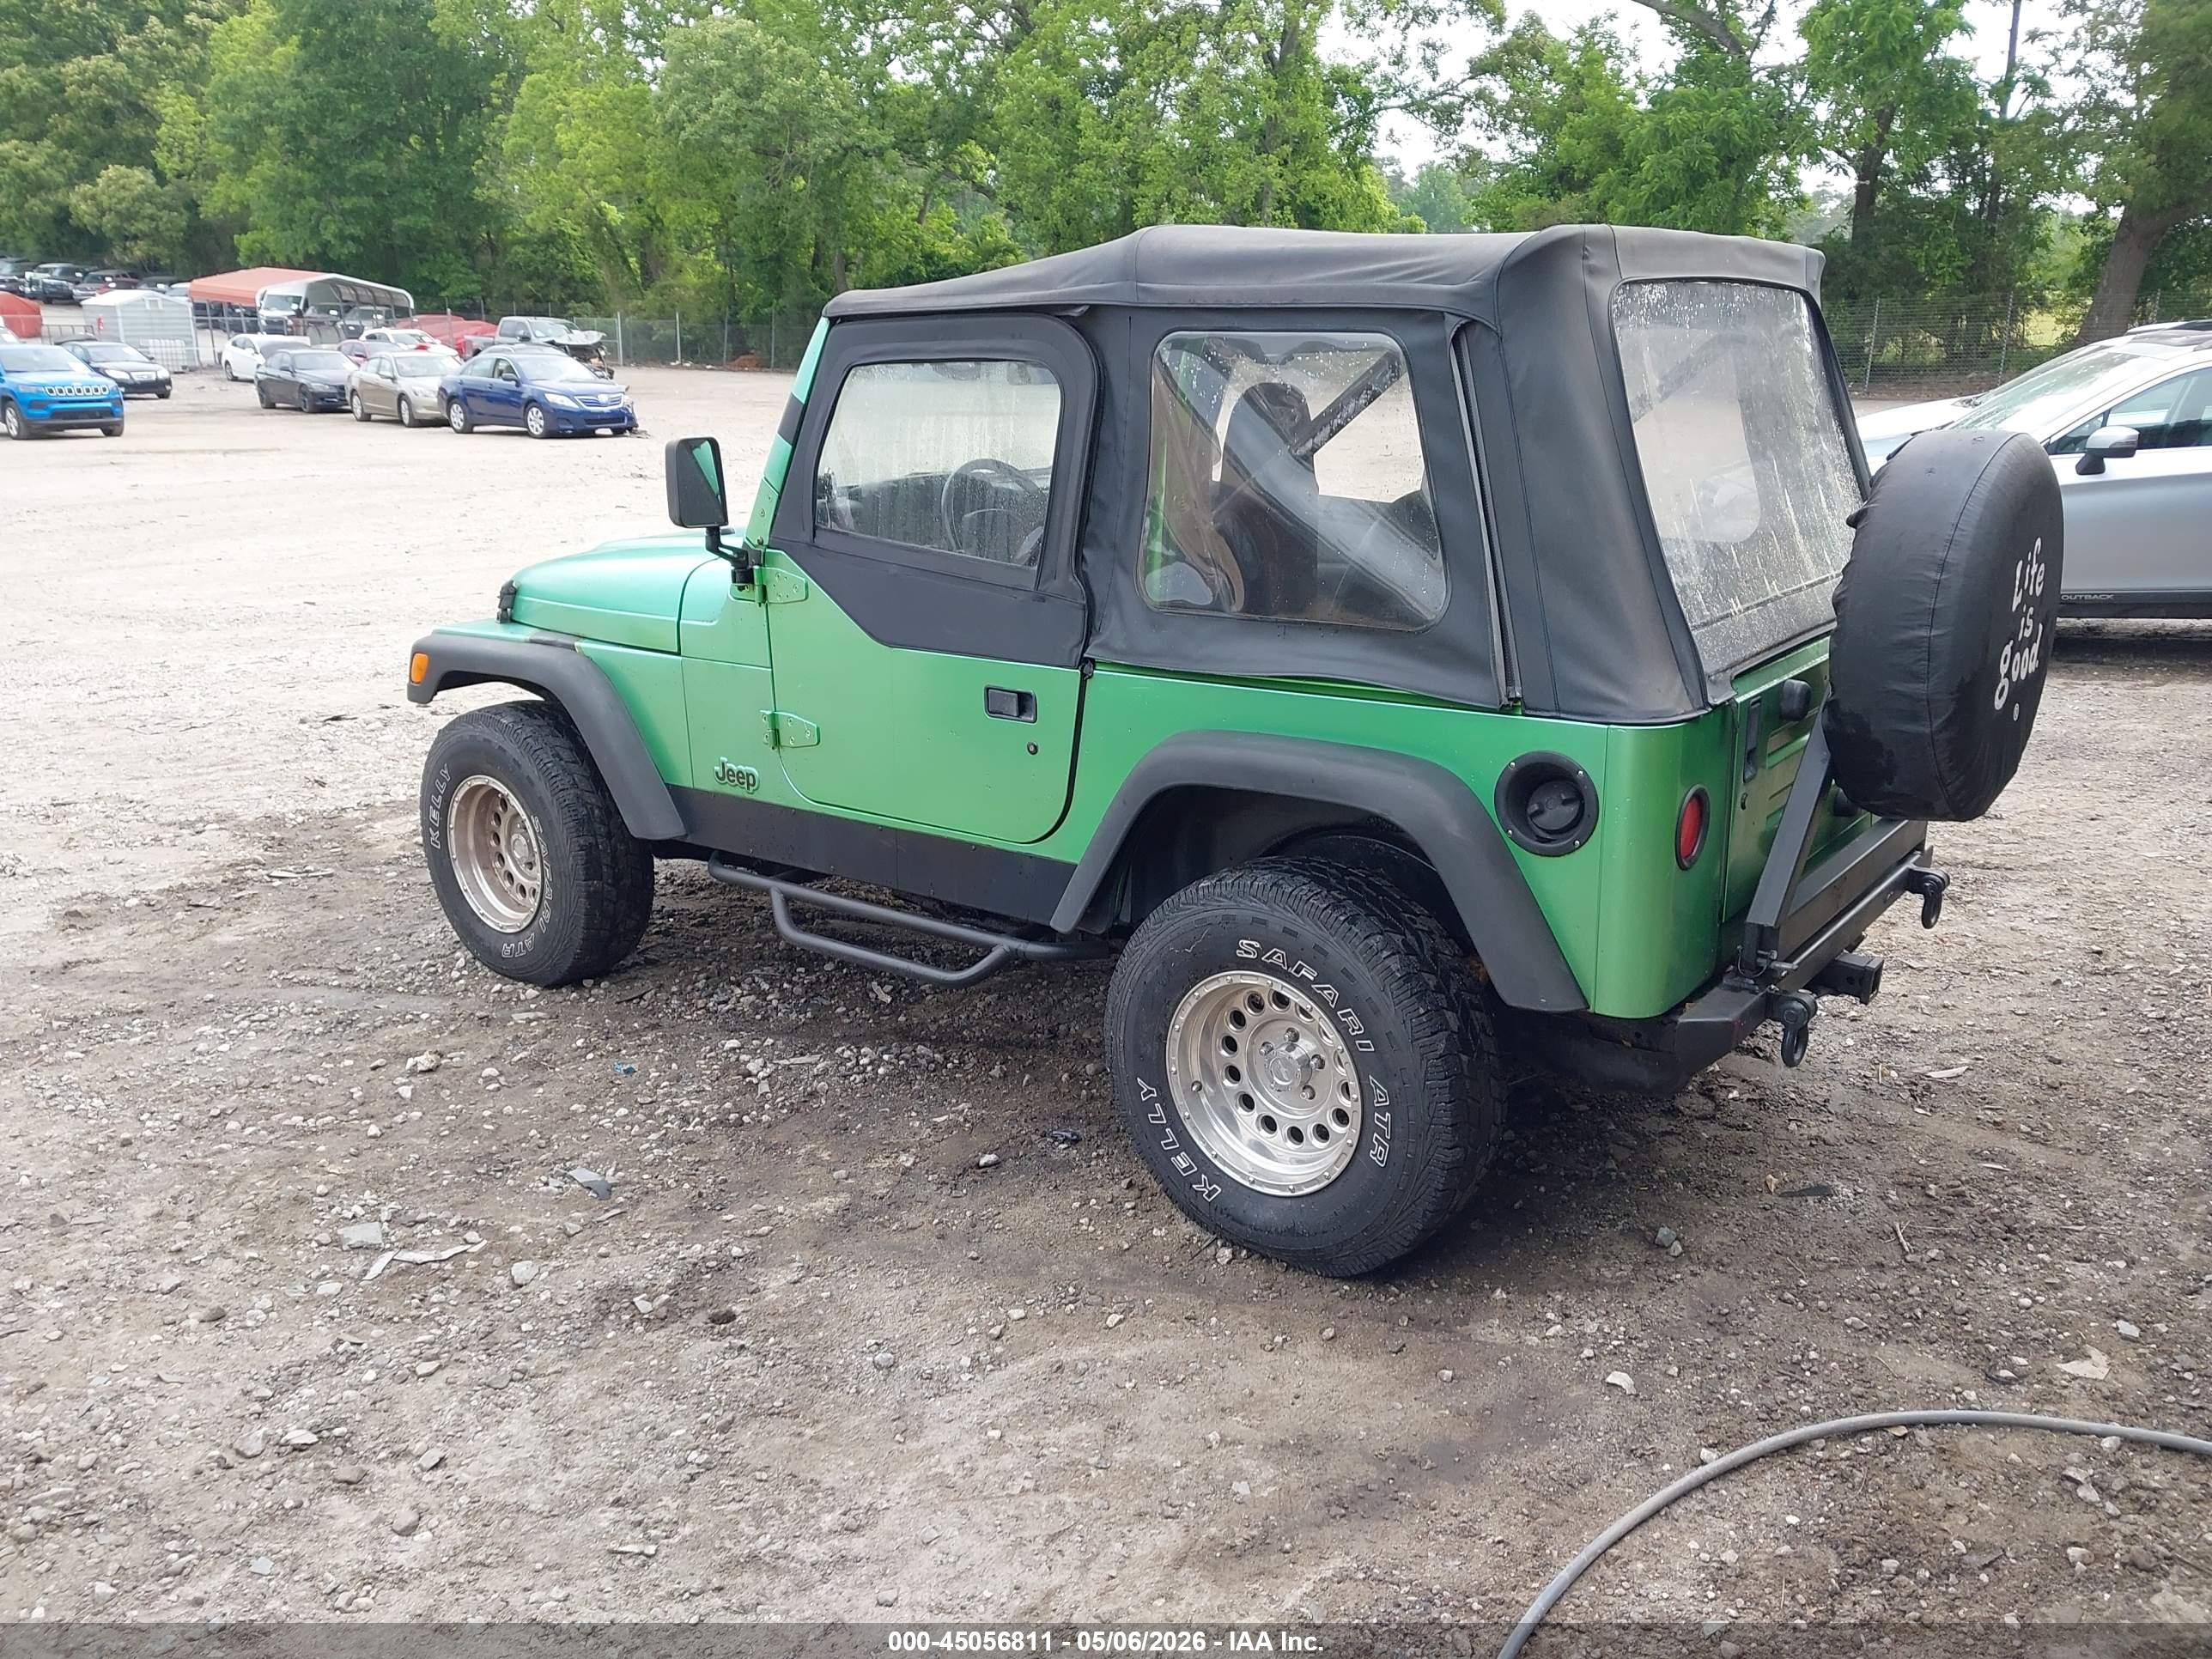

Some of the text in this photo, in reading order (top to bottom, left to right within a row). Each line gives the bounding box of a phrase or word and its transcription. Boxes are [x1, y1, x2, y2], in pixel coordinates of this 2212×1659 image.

[2011, 537, 2045, 612] Life
[2018, 604, 2034, 641] is
[430, 763, 452, 850] KELLY
[714, 757, 759, 793] Jeep
[501, 815, 554, 958] SAFARI ATR
[1236, 939, 1392, 1168] SAFARI ATR
[1136, 1076, 1222, 1202] KELLY
